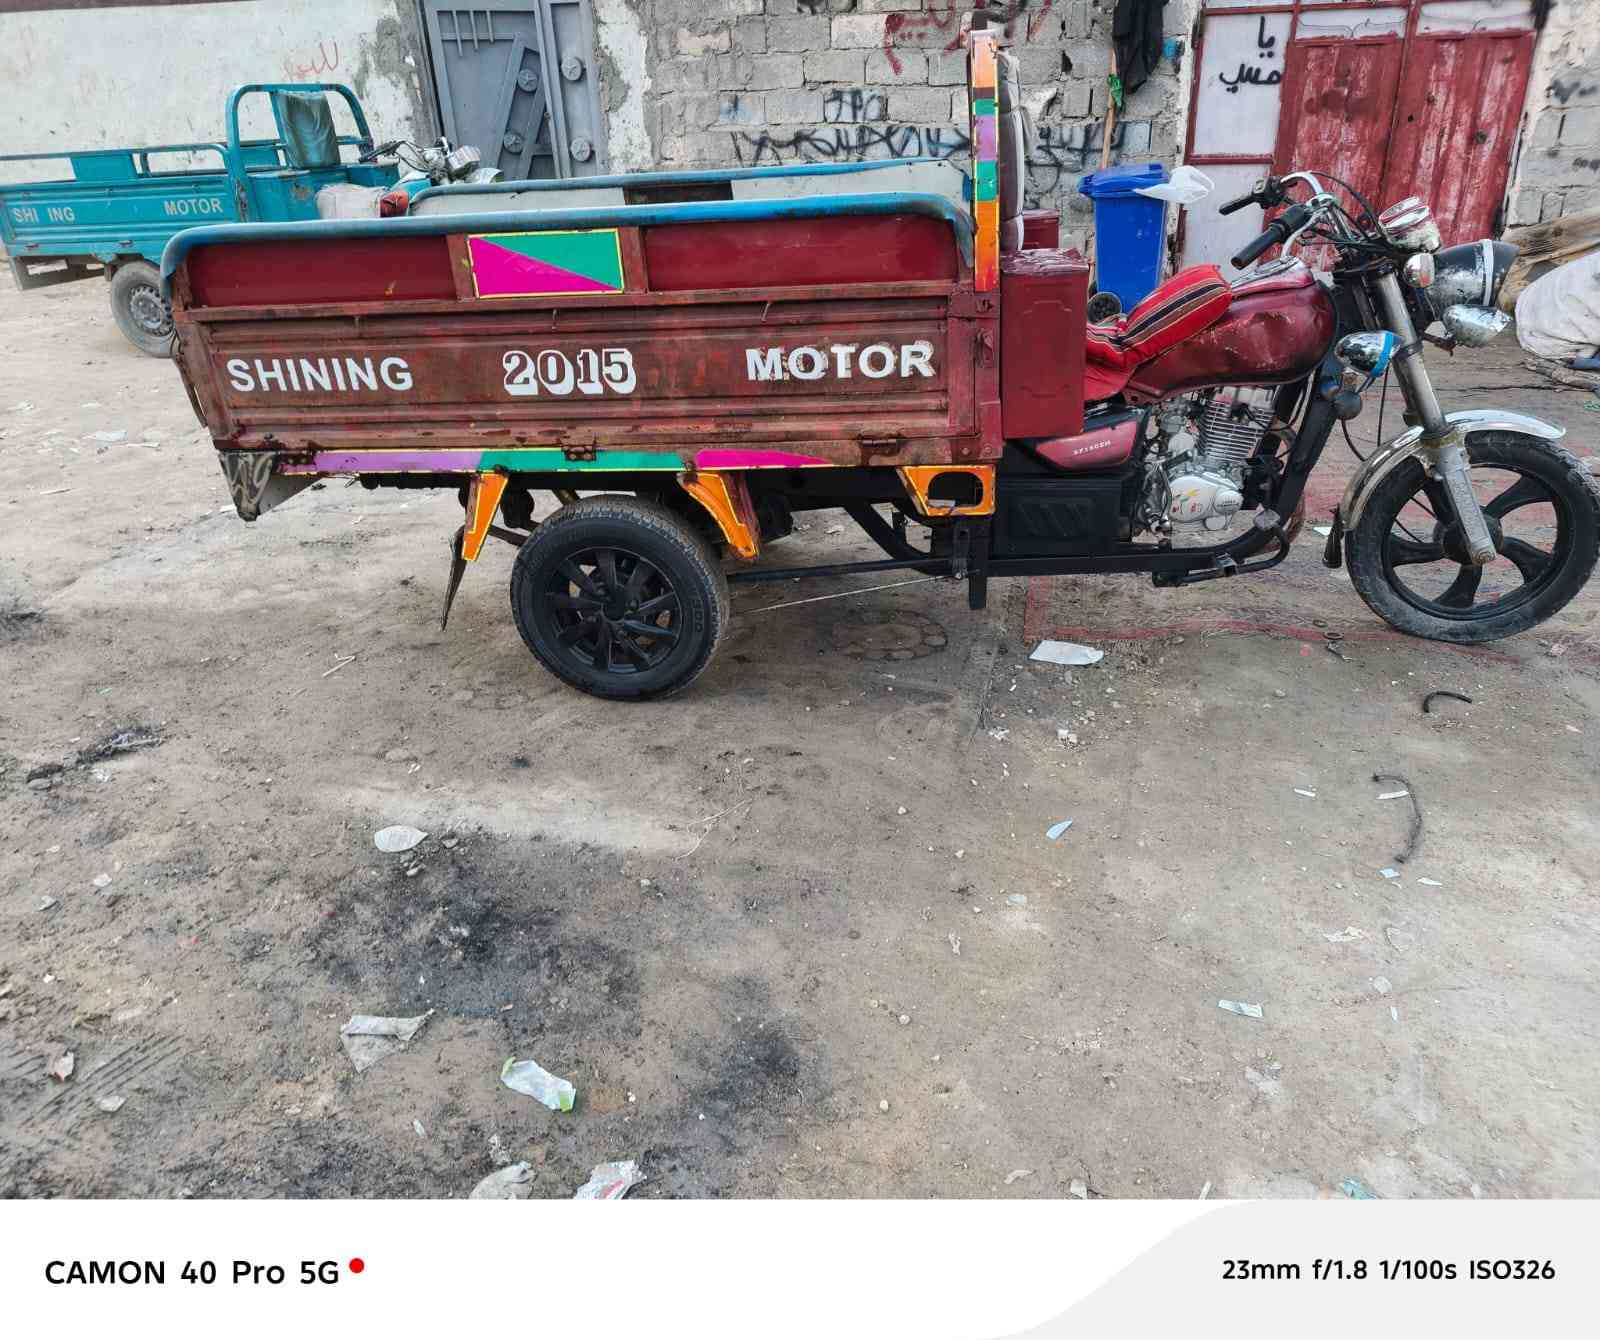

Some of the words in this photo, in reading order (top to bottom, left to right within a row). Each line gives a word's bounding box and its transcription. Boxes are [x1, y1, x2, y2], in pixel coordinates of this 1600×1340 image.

[163, 198, 224, 217] MOTOR
[226, 357, 414, 392] SHINING
[502, 348, 637, 396] 2015
[745, 340, 935, 381] MOTOR
